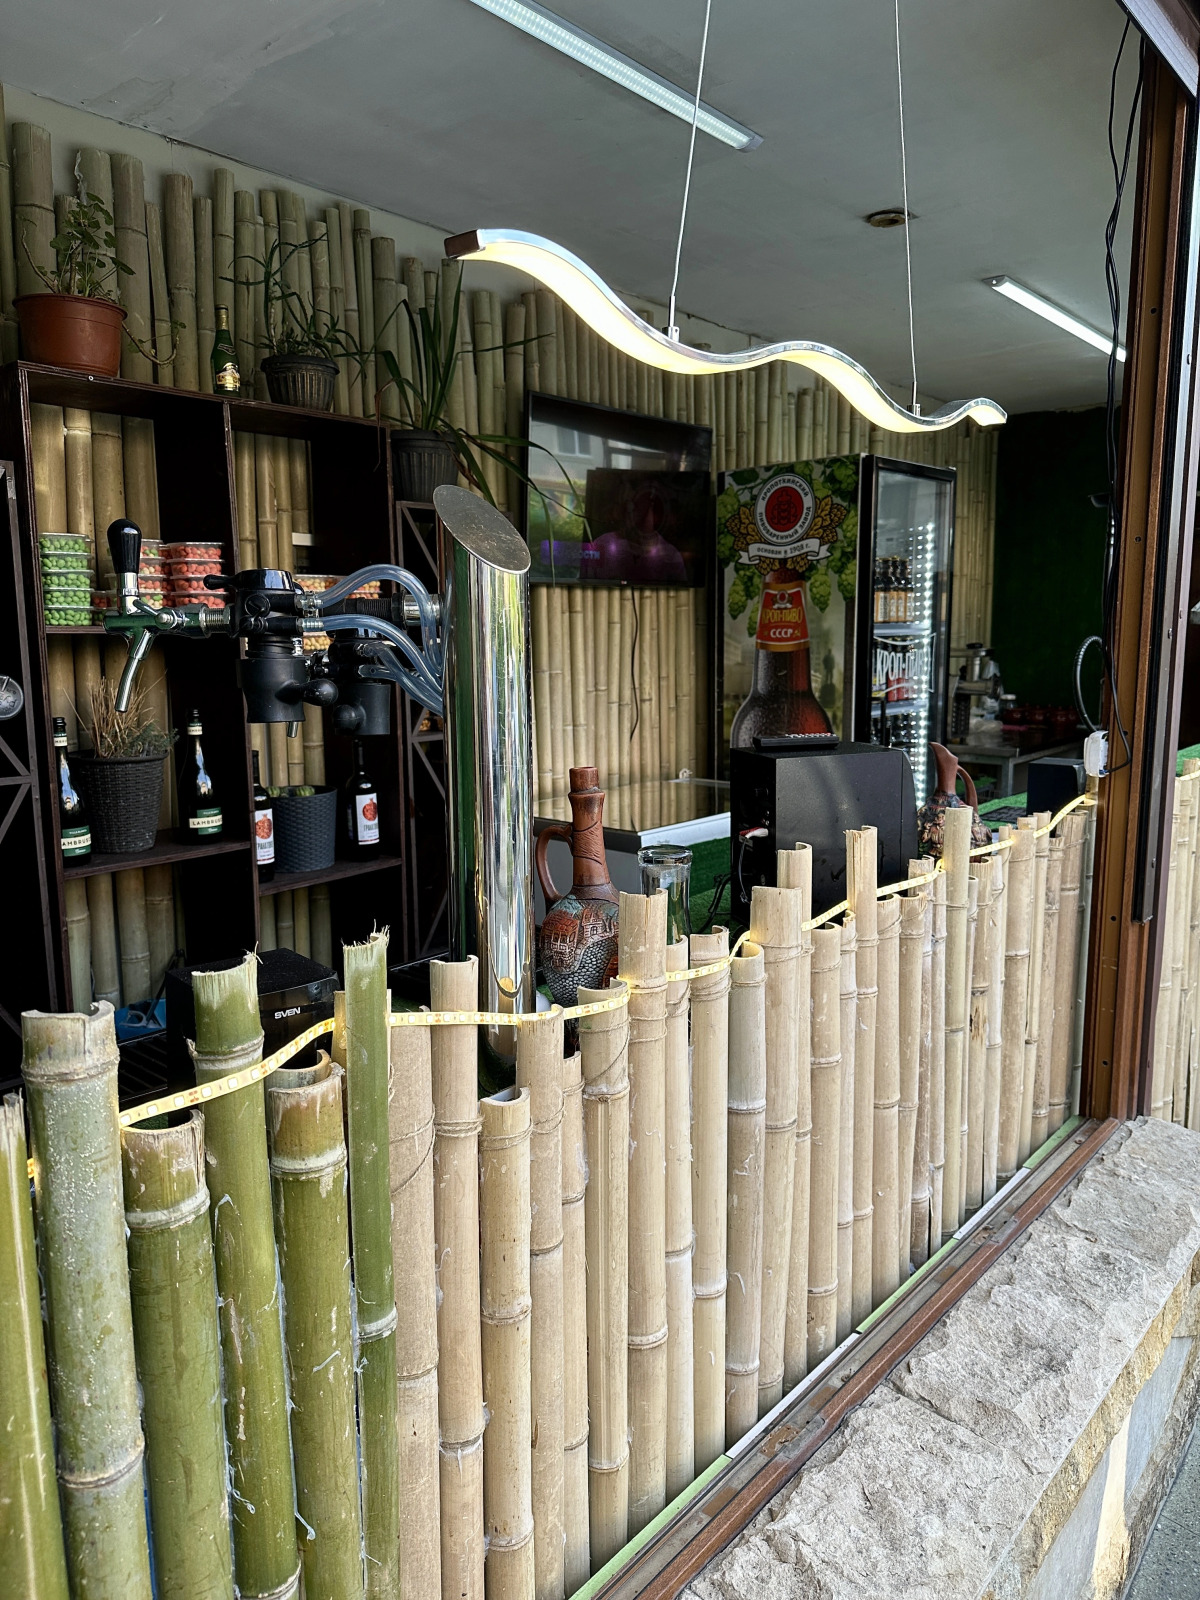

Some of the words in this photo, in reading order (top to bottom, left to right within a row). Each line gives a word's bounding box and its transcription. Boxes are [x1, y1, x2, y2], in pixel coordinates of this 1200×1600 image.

[761, 478, 809, 501] КРОПОТКИНСКИЙ
[758, 512, 799, 541] ПИВОВАРЕННЫЙ
[799, 506, 812, 530] ЗАВОД
[770, 628, 793, 638] СССР
[275, 1007, 300, 1019] SVEN
